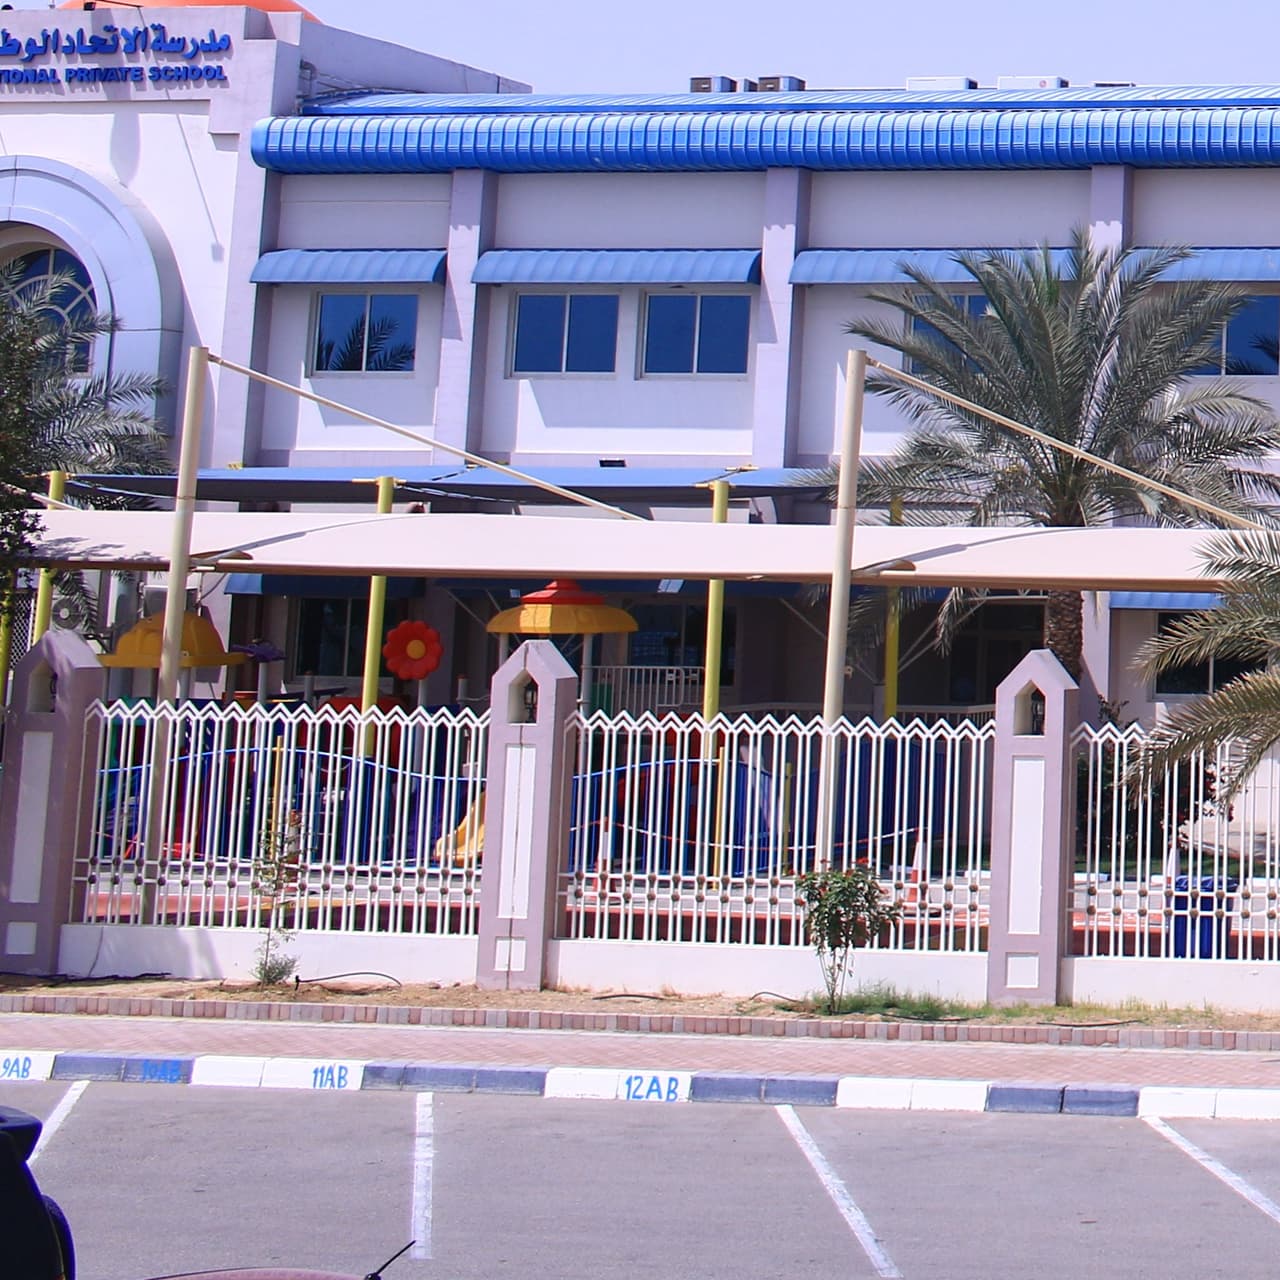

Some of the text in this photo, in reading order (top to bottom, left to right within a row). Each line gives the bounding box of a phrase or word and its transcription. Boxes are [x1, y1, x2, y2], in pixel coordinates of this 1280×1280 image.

[61, 24, 149, 55] الاتحاد
[150, 23, 231, 60] مدرسة
[65, 66, 145, 83] PRIVATE
[148, 64, 228, 81] SCHOOL
[312, 1063, 349, 1089] 11AB
[625, 1074, 679, 1102] 12AB
